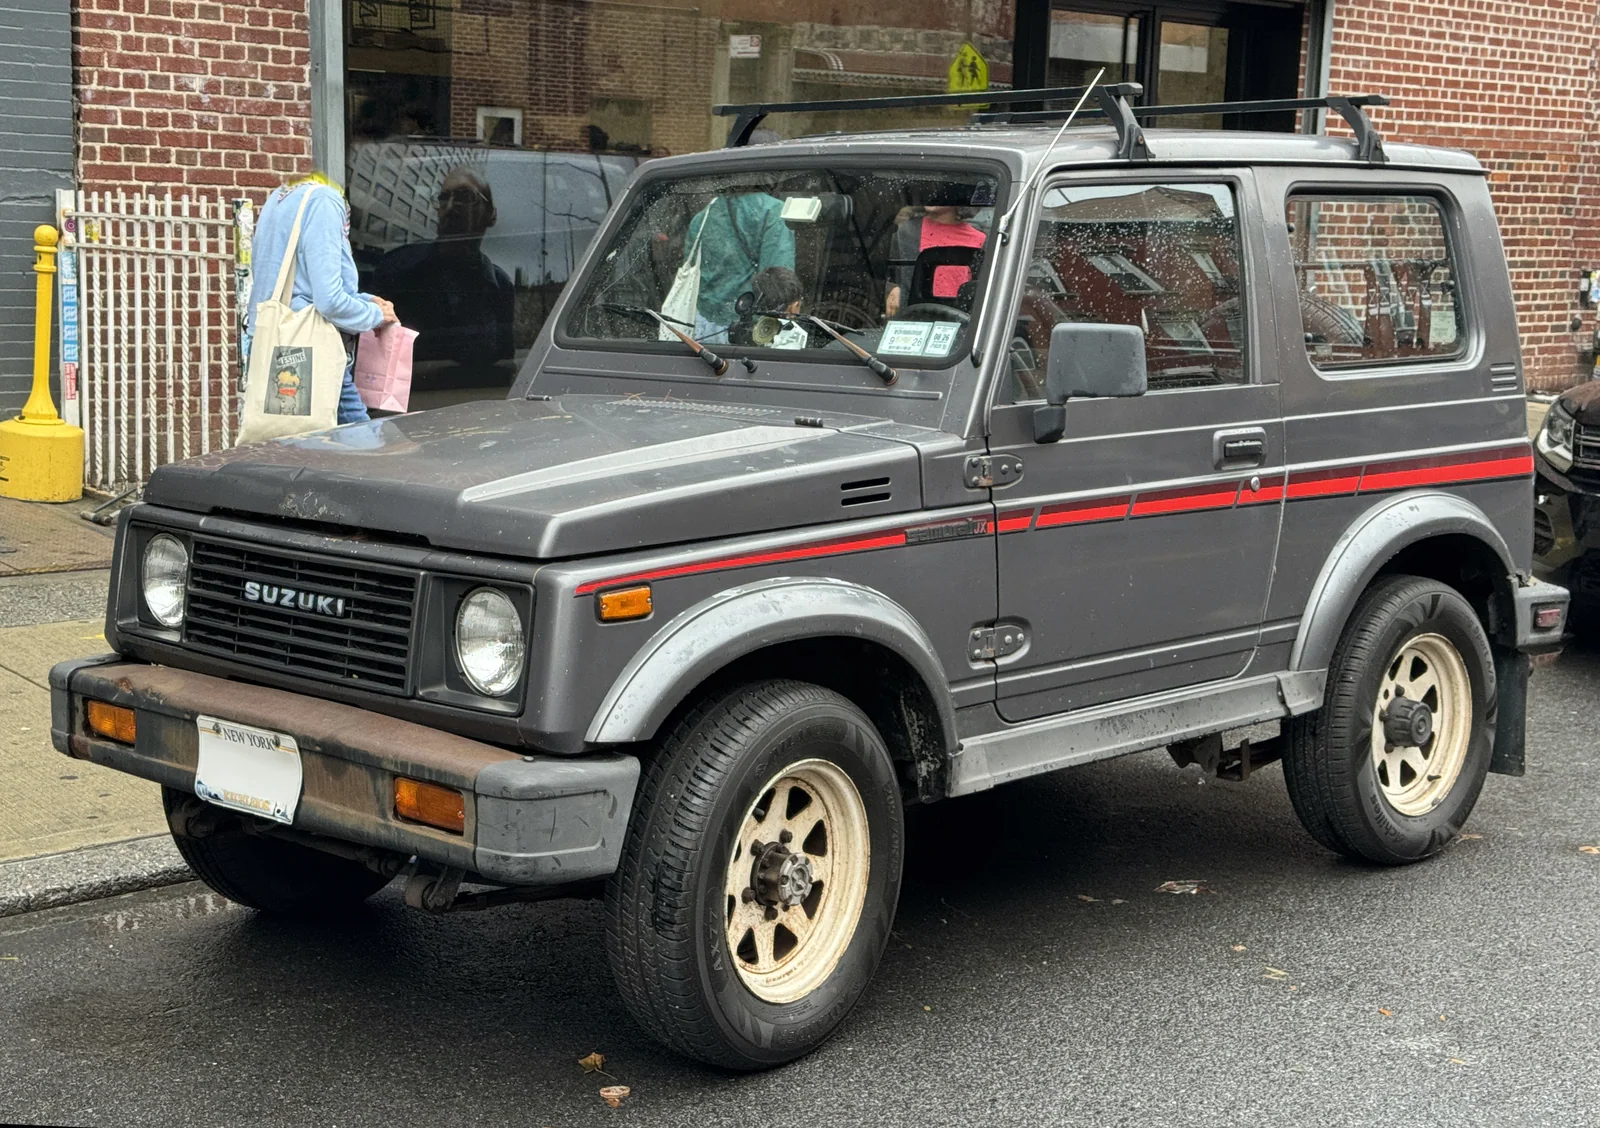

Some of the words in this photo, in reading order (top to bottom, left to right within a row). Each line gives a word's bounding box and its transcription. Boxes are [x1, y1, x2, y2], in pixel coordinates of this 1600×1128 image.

[973, 519, 988, 534] JX
[244, 581, 346, 617] SUZUKI
[223, 727, 245, 744] NEW
[246, 732, 276, 752] YORK
